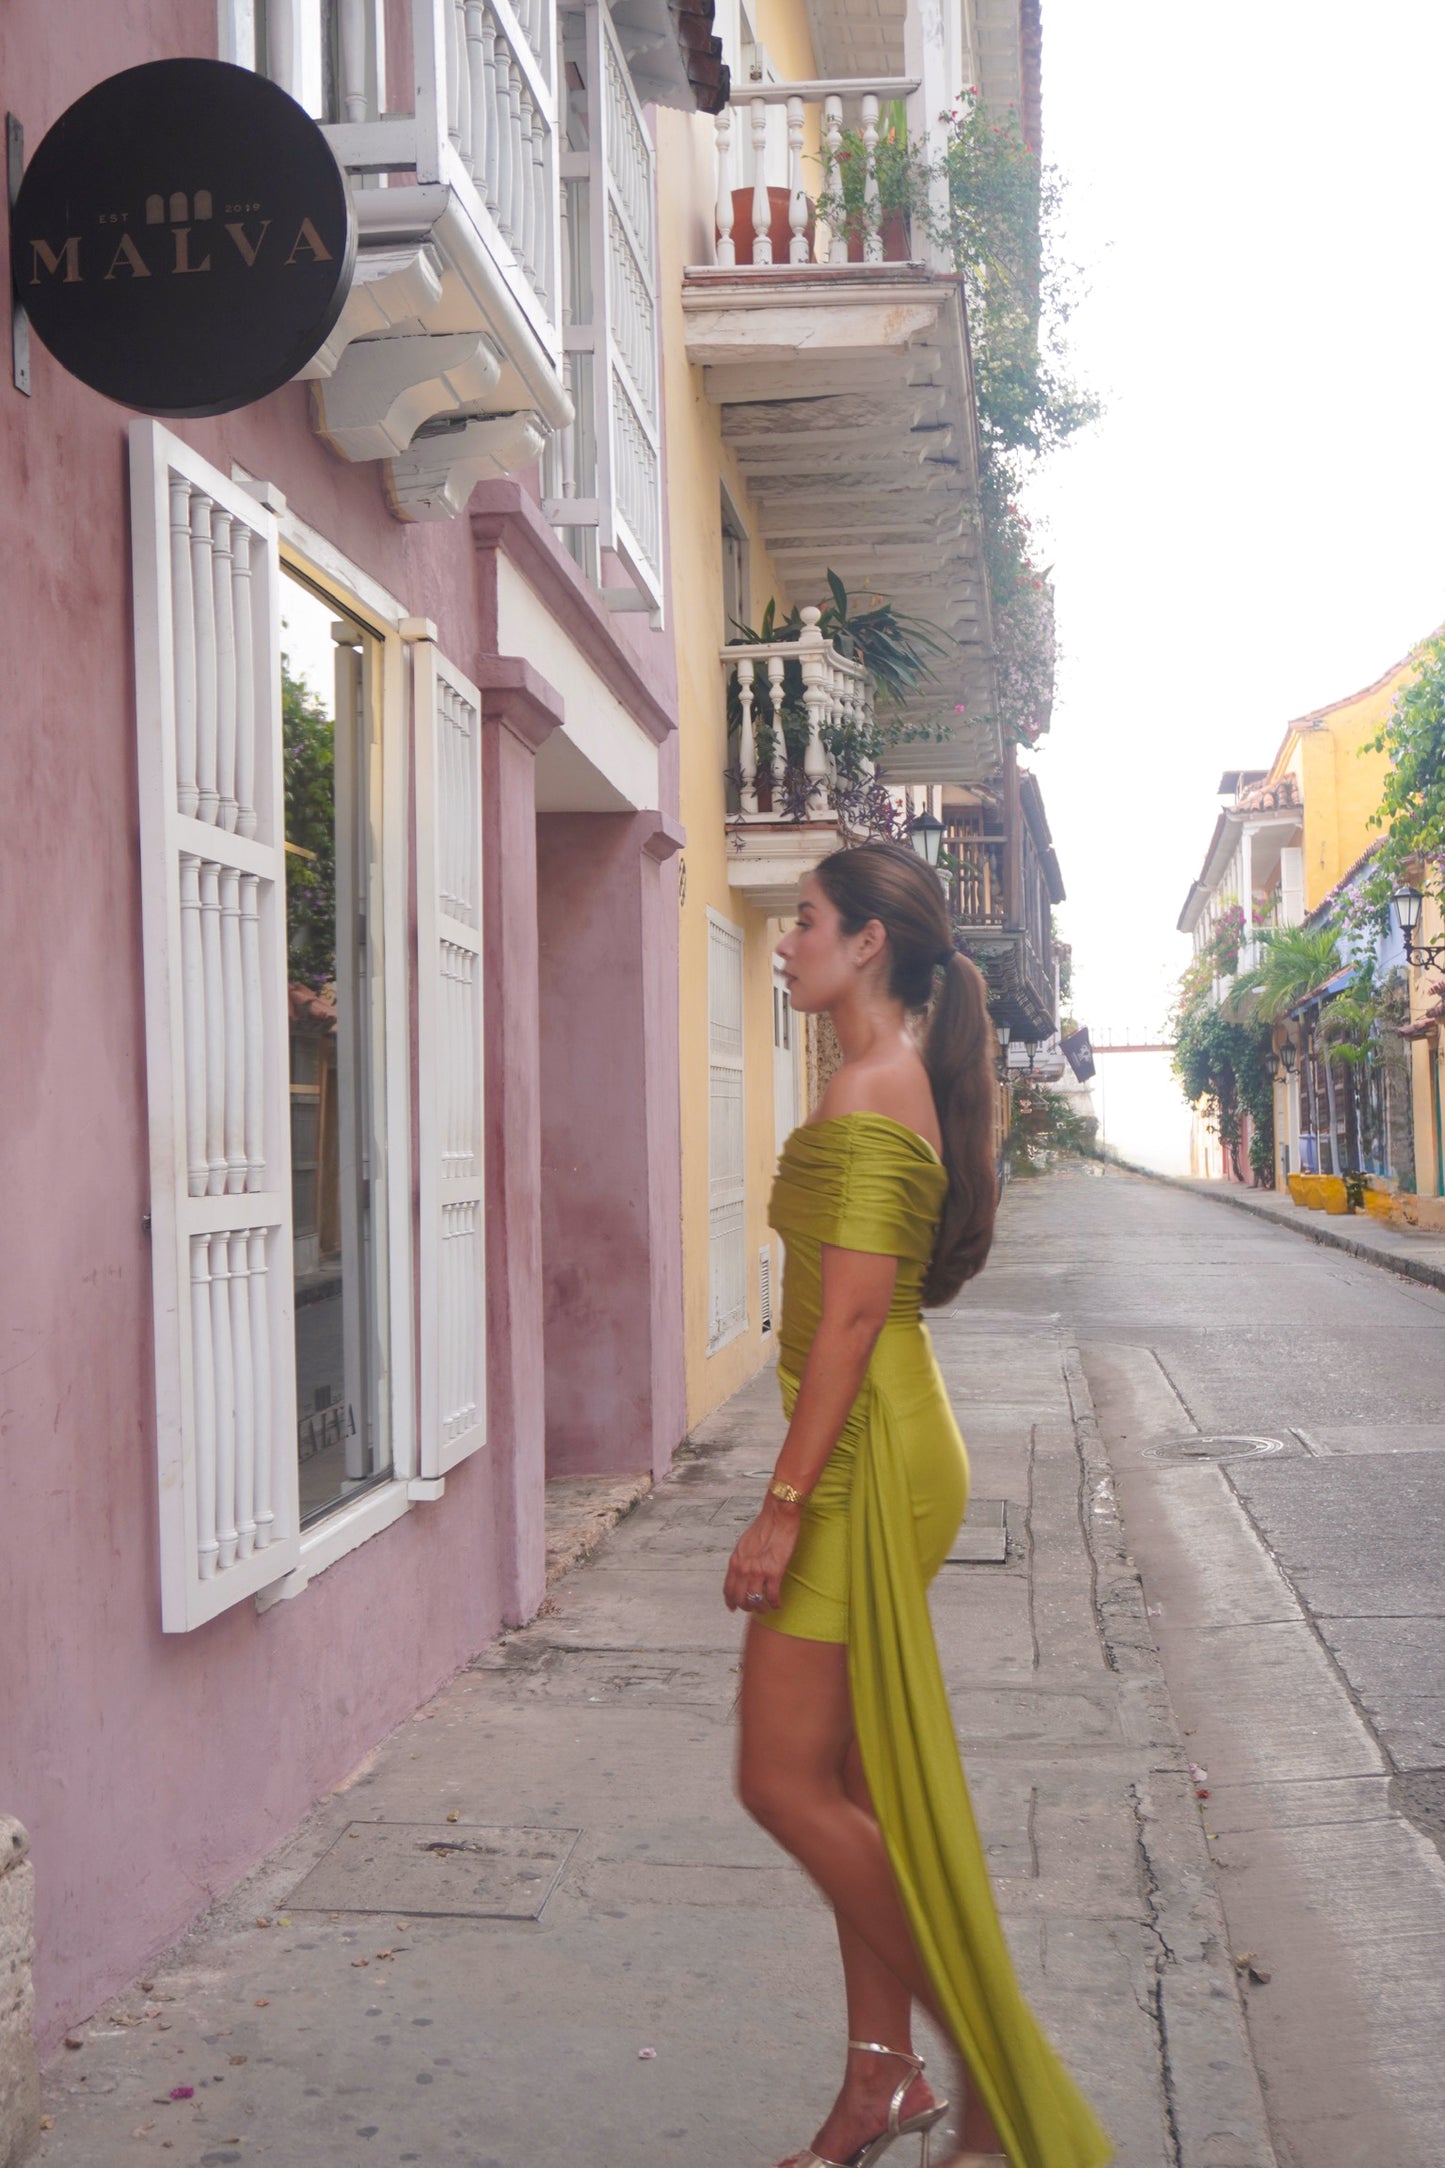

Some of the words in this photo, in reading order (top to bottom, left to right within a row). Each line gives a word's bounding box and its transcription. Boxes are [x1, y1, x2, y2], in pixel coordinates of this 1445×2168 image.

[99, 213, 129, 224] EST
[224, 203, 262, 214] 2019
[29, 217, 335, 285] MALVA
